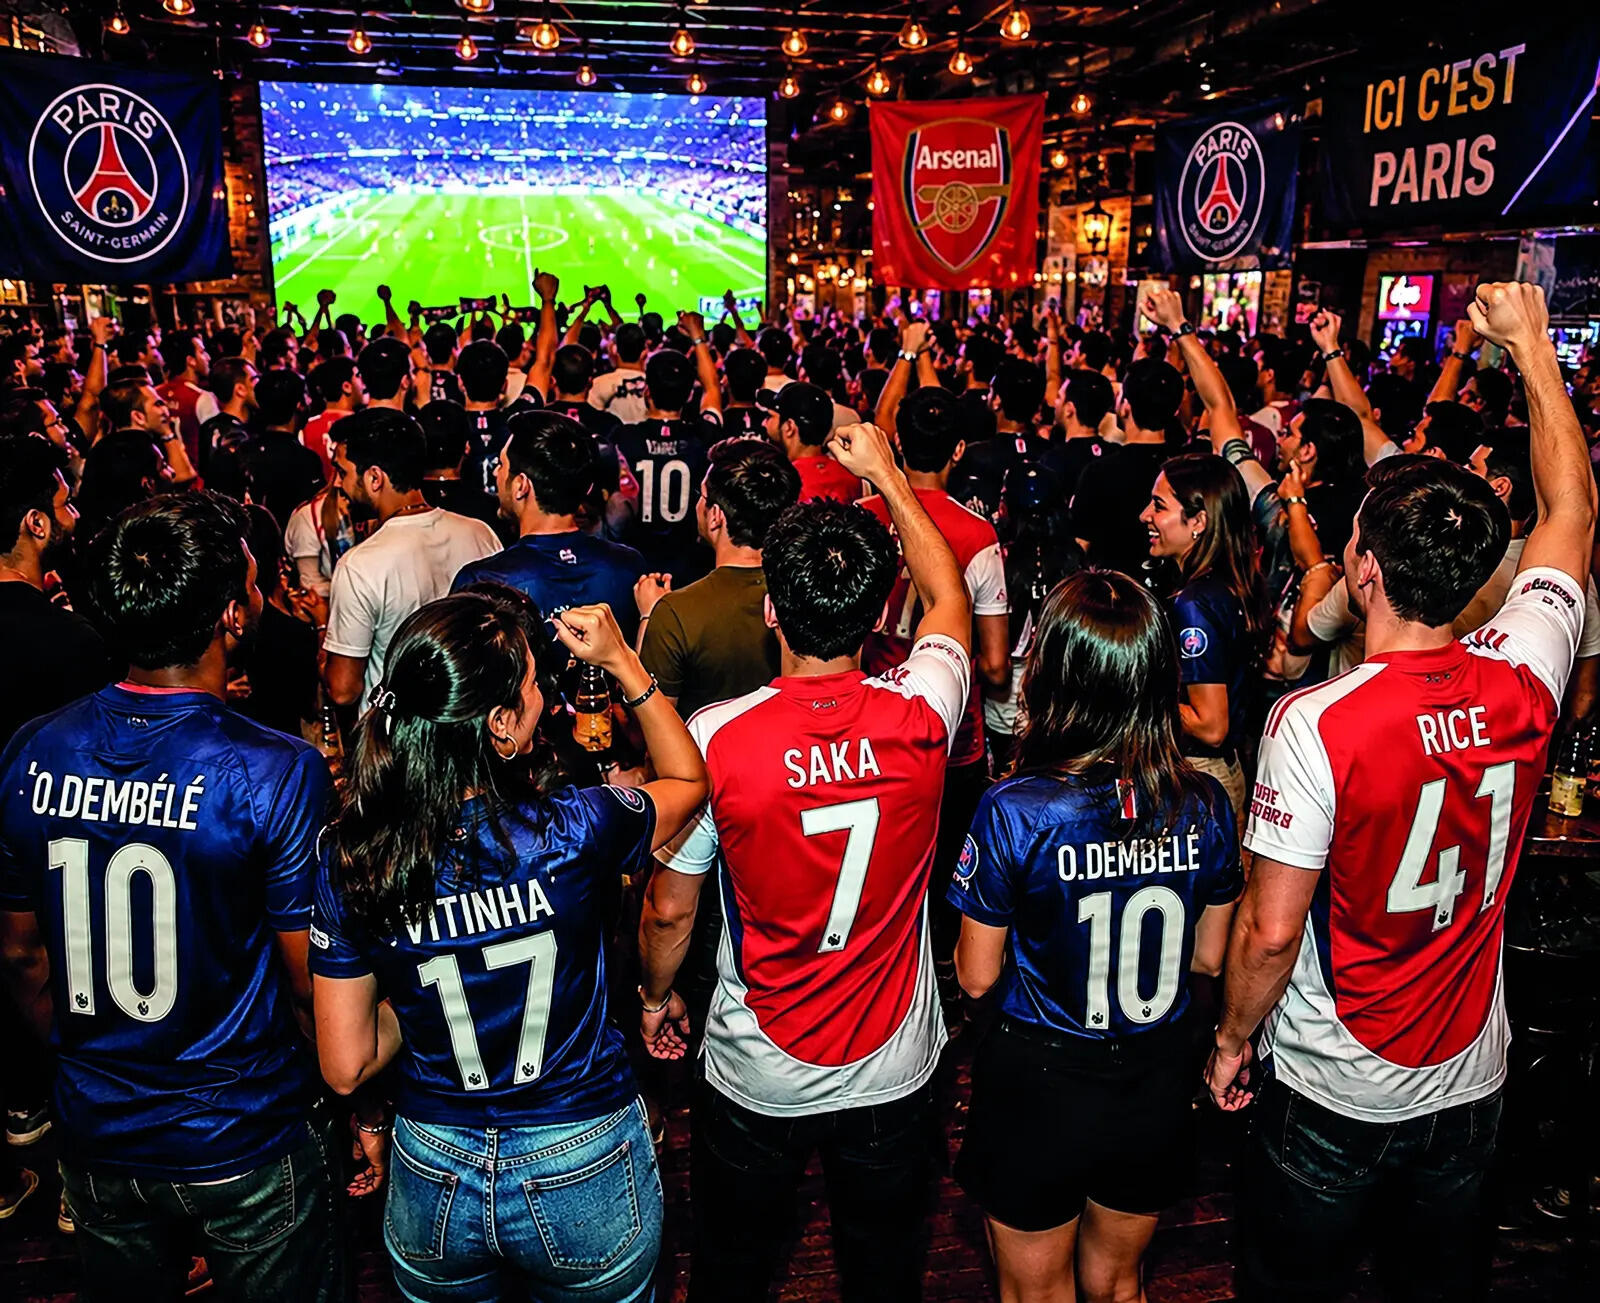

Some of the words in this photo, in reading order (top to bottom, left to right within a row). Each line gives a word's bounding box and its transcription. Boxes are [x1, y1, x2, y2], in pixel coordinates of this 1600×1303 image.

[52, 92, 158, 139] PARIS
[1363, 76, 1406, 133] ICI
[1417, 43, 1526, 121] C'EST
[917, 143, 998, 170] Arsenal
[1195, 128, 1252, 166] PARIS
[1369, 134, 1497, 207] PARIS
[61, 211, 169, 249] SAINT-GERMAIN
[636, 459, 691, 523] 10
[783, 737, 881, 789] SAKA
[1416, 705, 1491, 757] RICE
[800, 796, 881, 954] 7
[1057, 824, 1200, 881] O.DEMBÉLÉ
[1386, 760, 1516, 932] 41
[48, 837, 178, 1022] 10
[1077, 885, 1186, 1030] 10
[417, 929, 558, 1091] 17
